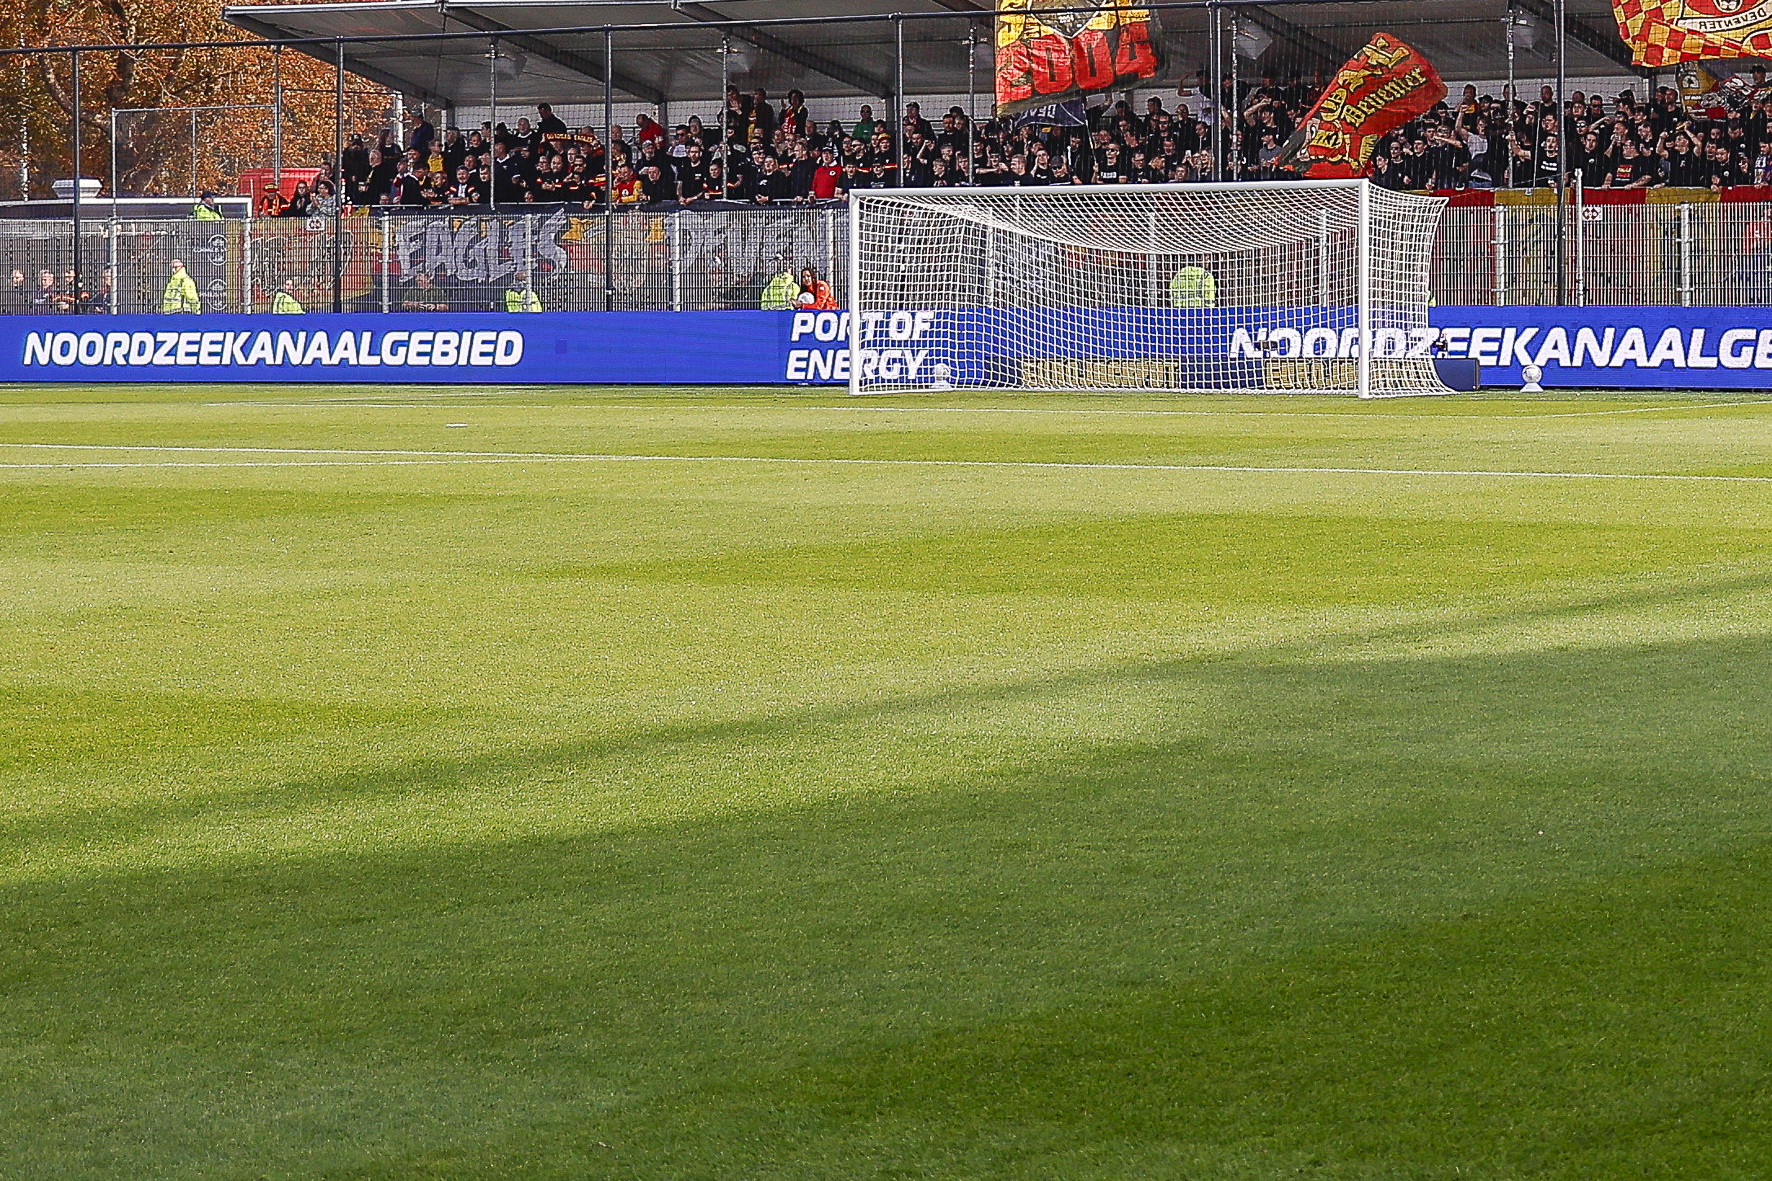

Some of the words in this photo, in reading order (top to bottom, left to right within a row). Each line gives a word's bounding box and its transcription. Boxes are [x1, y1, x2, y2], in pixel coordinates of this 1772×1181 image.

[997, 22, 1160, 105] 2004
[1341, 66, 1427, 128] Deventer
[398, 208, 567, 284] EAGLES
[22, 331, 525, 366] NOORDZEEKANAALGEBIED
[889, 311, 935, 341] OF
[785, 349, 929, 380] ENERGY
